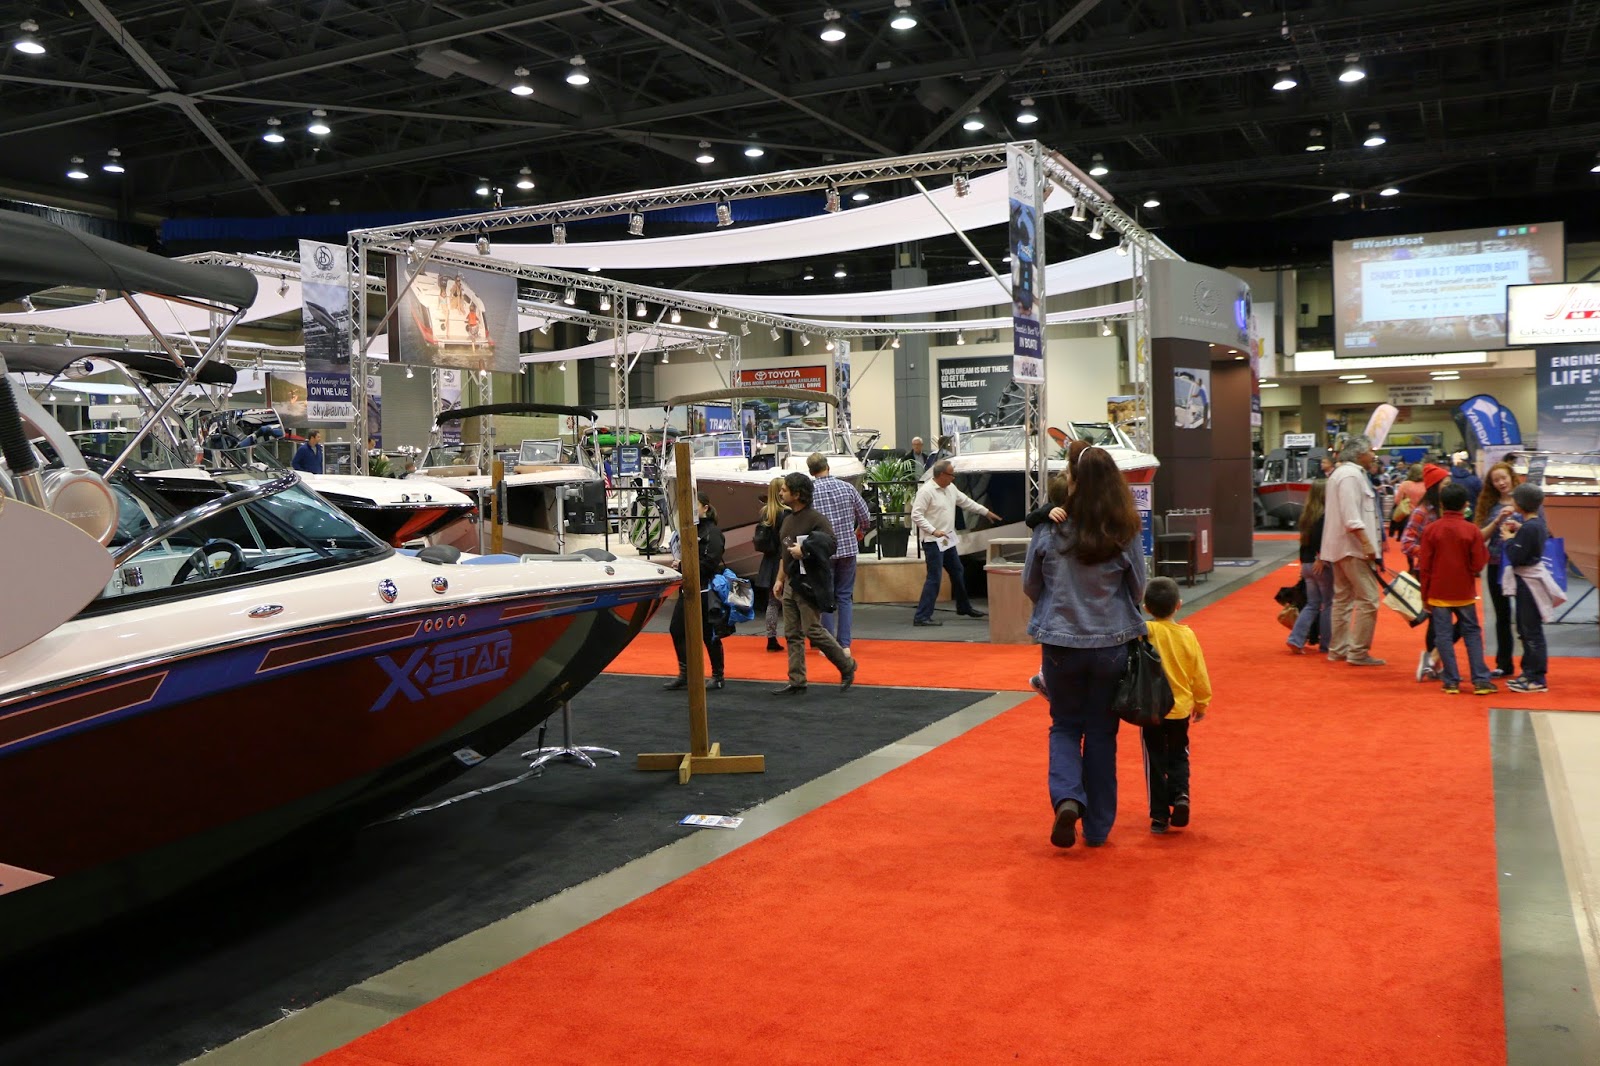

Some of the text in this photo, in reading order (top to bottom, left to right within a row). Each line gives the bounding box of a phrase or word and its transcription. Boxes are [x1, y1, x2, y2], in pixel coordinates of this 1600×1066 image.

[1352, 236, 1424, 249] #IWantABoat
[1370, 271, 1400, 281] CHANCE
[1403, 269, 1413, 279] TO
[1415, 268, 1430, 278] WIN
[1432, 267, 1438, 276] A
[1455, 263, 1492, 275] PONTOON
[768, 370, 800, 378] TOYOTA
[974, 366, 980, 374] IS
[991, 365, 1010, 373] THERE.
[308, 376, 319, 384] Best
[1551, 368, 1600, 385] LIFE'
[957, 380, 980, 388] PROTECT
[980, 379, 988, 387] IT.
[311, 387, 348, 396] ON THE LAKE
[709, 418, 736, 430] TRACK
